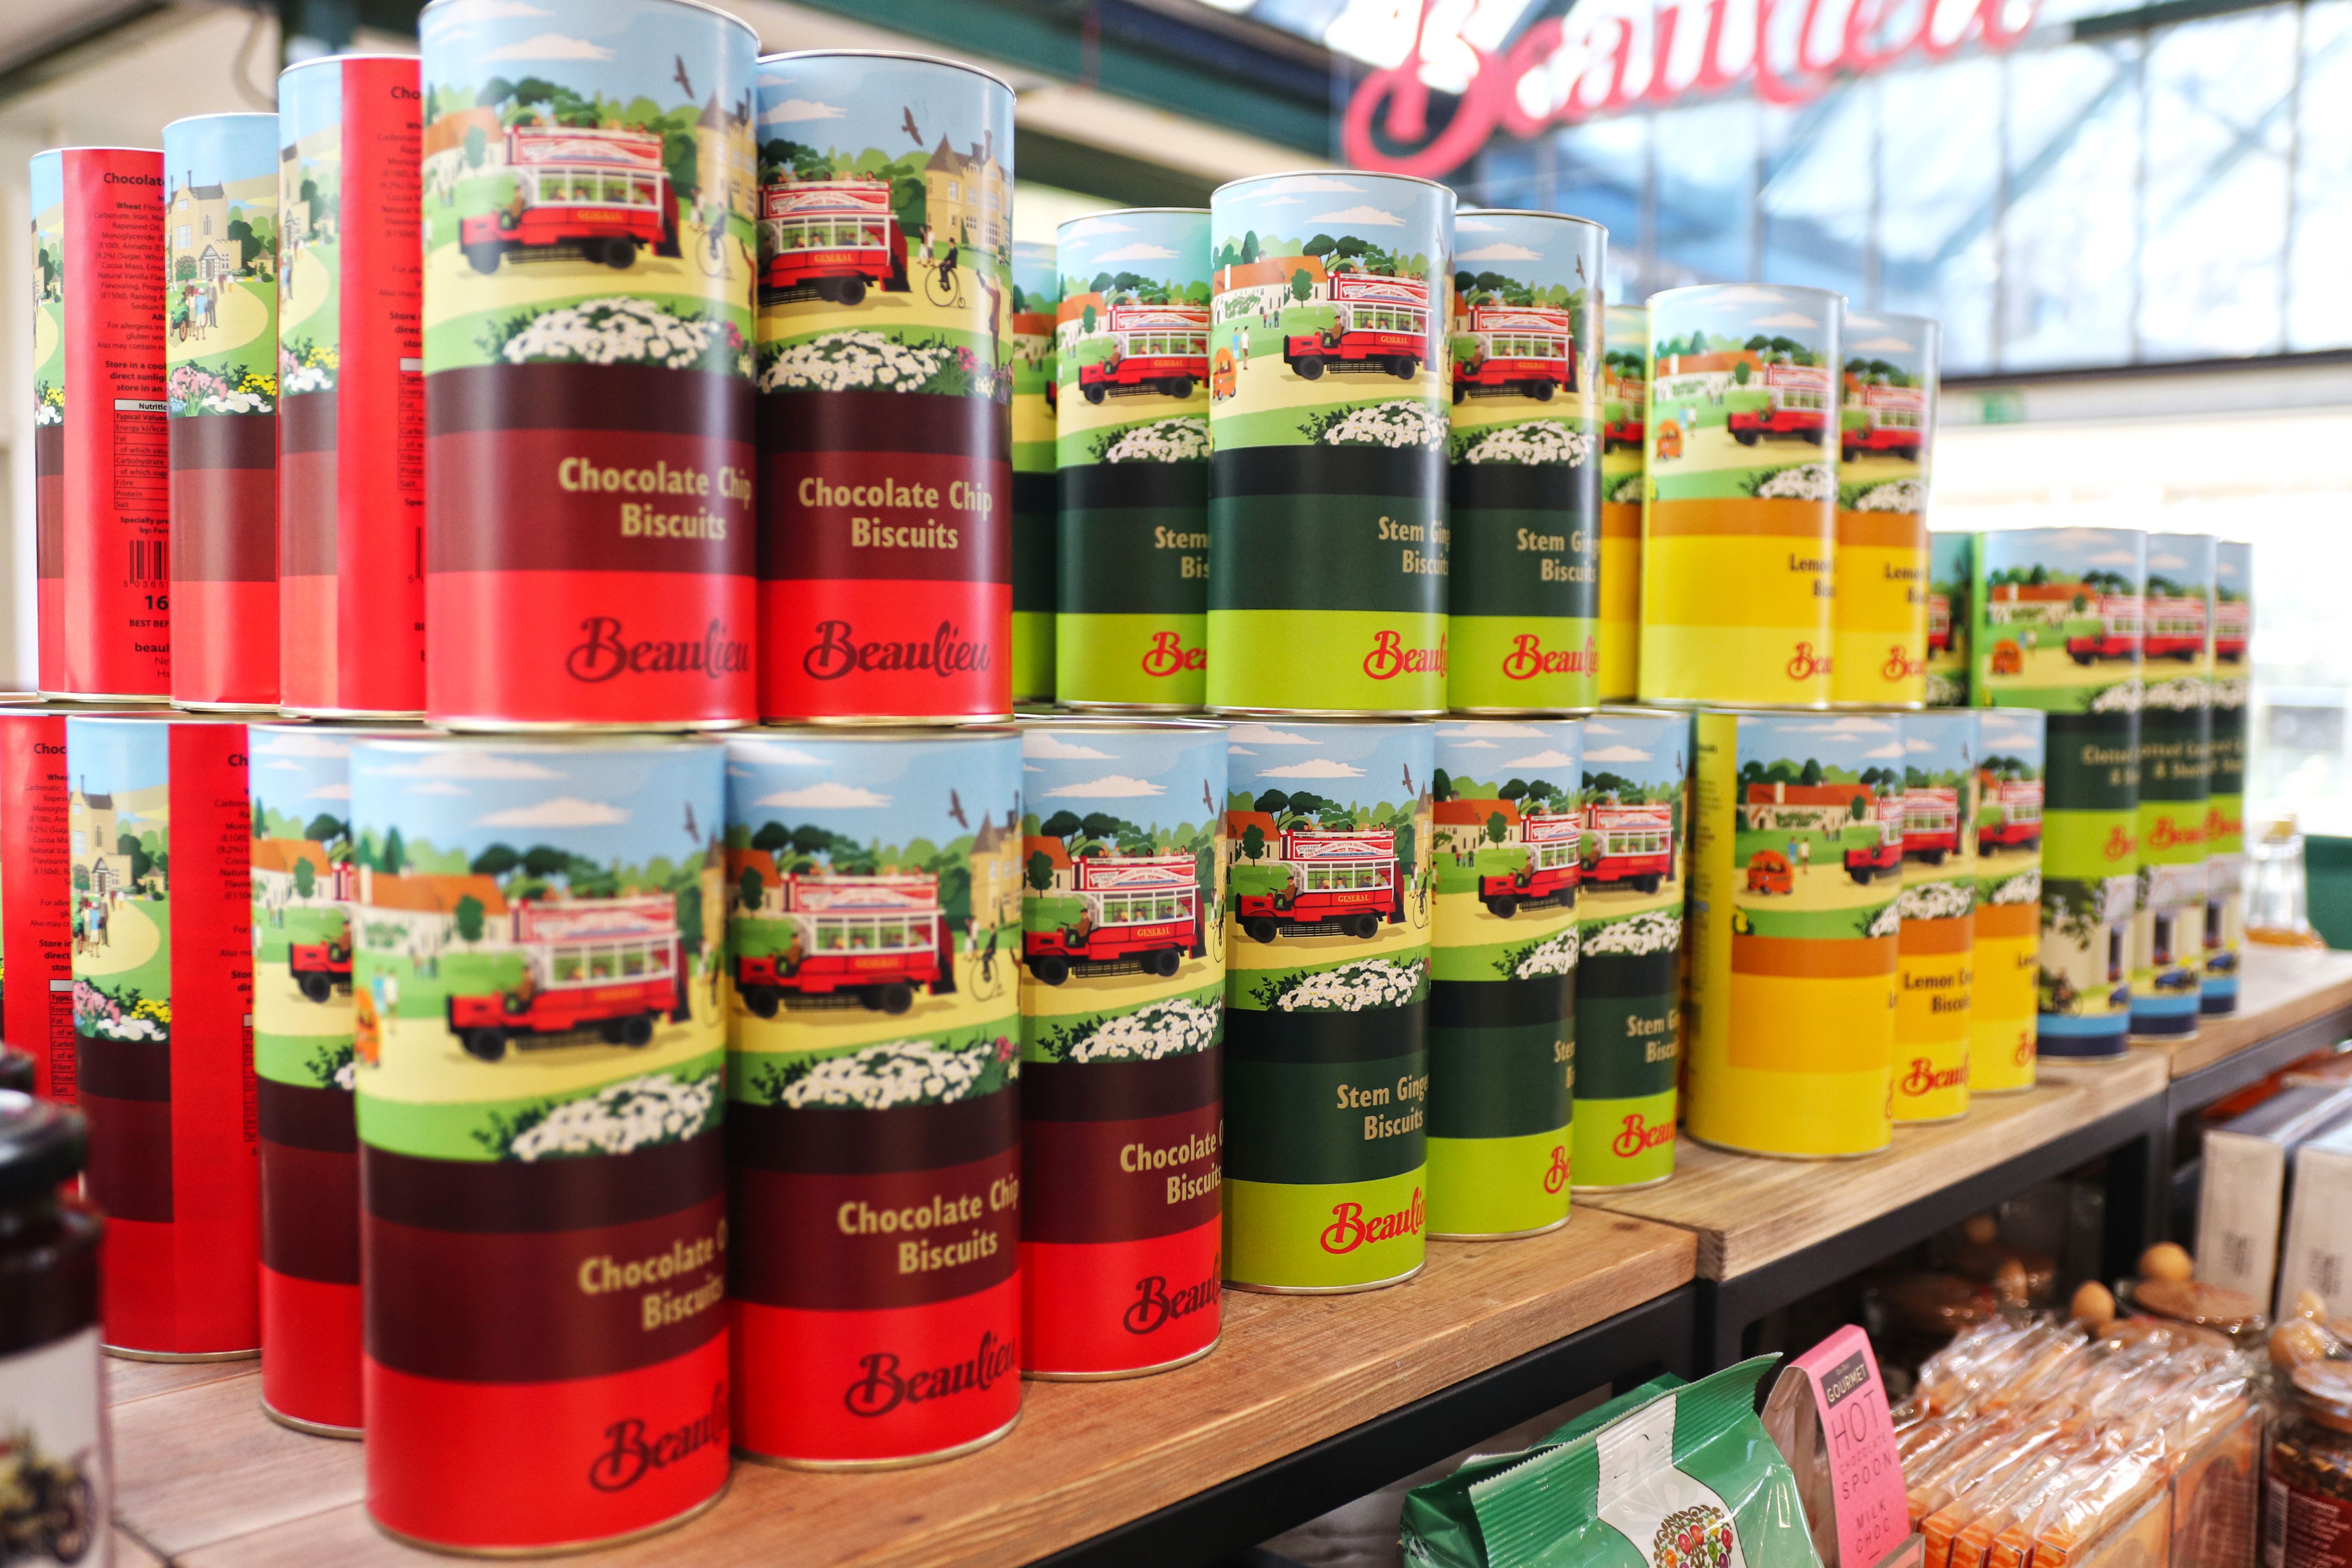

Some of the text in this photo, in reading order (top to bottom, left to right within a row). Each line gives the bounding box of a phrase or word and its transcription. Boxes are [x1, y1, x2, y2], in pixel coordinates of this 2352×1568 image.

[143, 283, 166, 292] Propy
[558, 457, 751, 509] Chocolate Chip
[799, 478, 993, 521] Chocolate Chip
[620, 502, 727, 540] Biscuits
[851, 517, 958, 549] Biscuits
[1379, 516, 1424, 542] Stem
[1517, 528, 1565, 551] Stem
[1402, 549, 1449, 576] Biscuits
[1541, 558, 1597, 583] Biscuits
[566, 616, 750, 684] Beaulieu
[803, 620, 991, 680] Beaulieu
[1338, 894, 1369, 903] GENERAL
[1137, 926, 1171, 937] GENERAL
[1904, 971, 1955, 990] Lemon
[1626, 1014, 1665, 1037] Stem
[1337, 1084, 1390, 1109] Stem
[1364, 1106, 1423, 1140] Biscuits
[1120, 1133, 1216, 1173] Chocolate
[1167, 1162, 1222, 1205] Biscuits
[837, 1172, 1019, 1235] Chocolate Chip
[577, 1237, 715, 1295] Chocolate
[898, 1227, 998, 1274] Biscuits
[642, 1274, 724, 1332] Biscuits
[1827, 1364, 1867, 1402] GOURMET
[1831, 1389, 1879, 1458] HOT
[1839, 1433, 1887, 1474] CHOCOLATE
[1843, 1449, 1891, 1500] SPOON
[1856, 1497, 1886, 1528] MILK
[1856, 1518, 1889, 1553] CHOC
